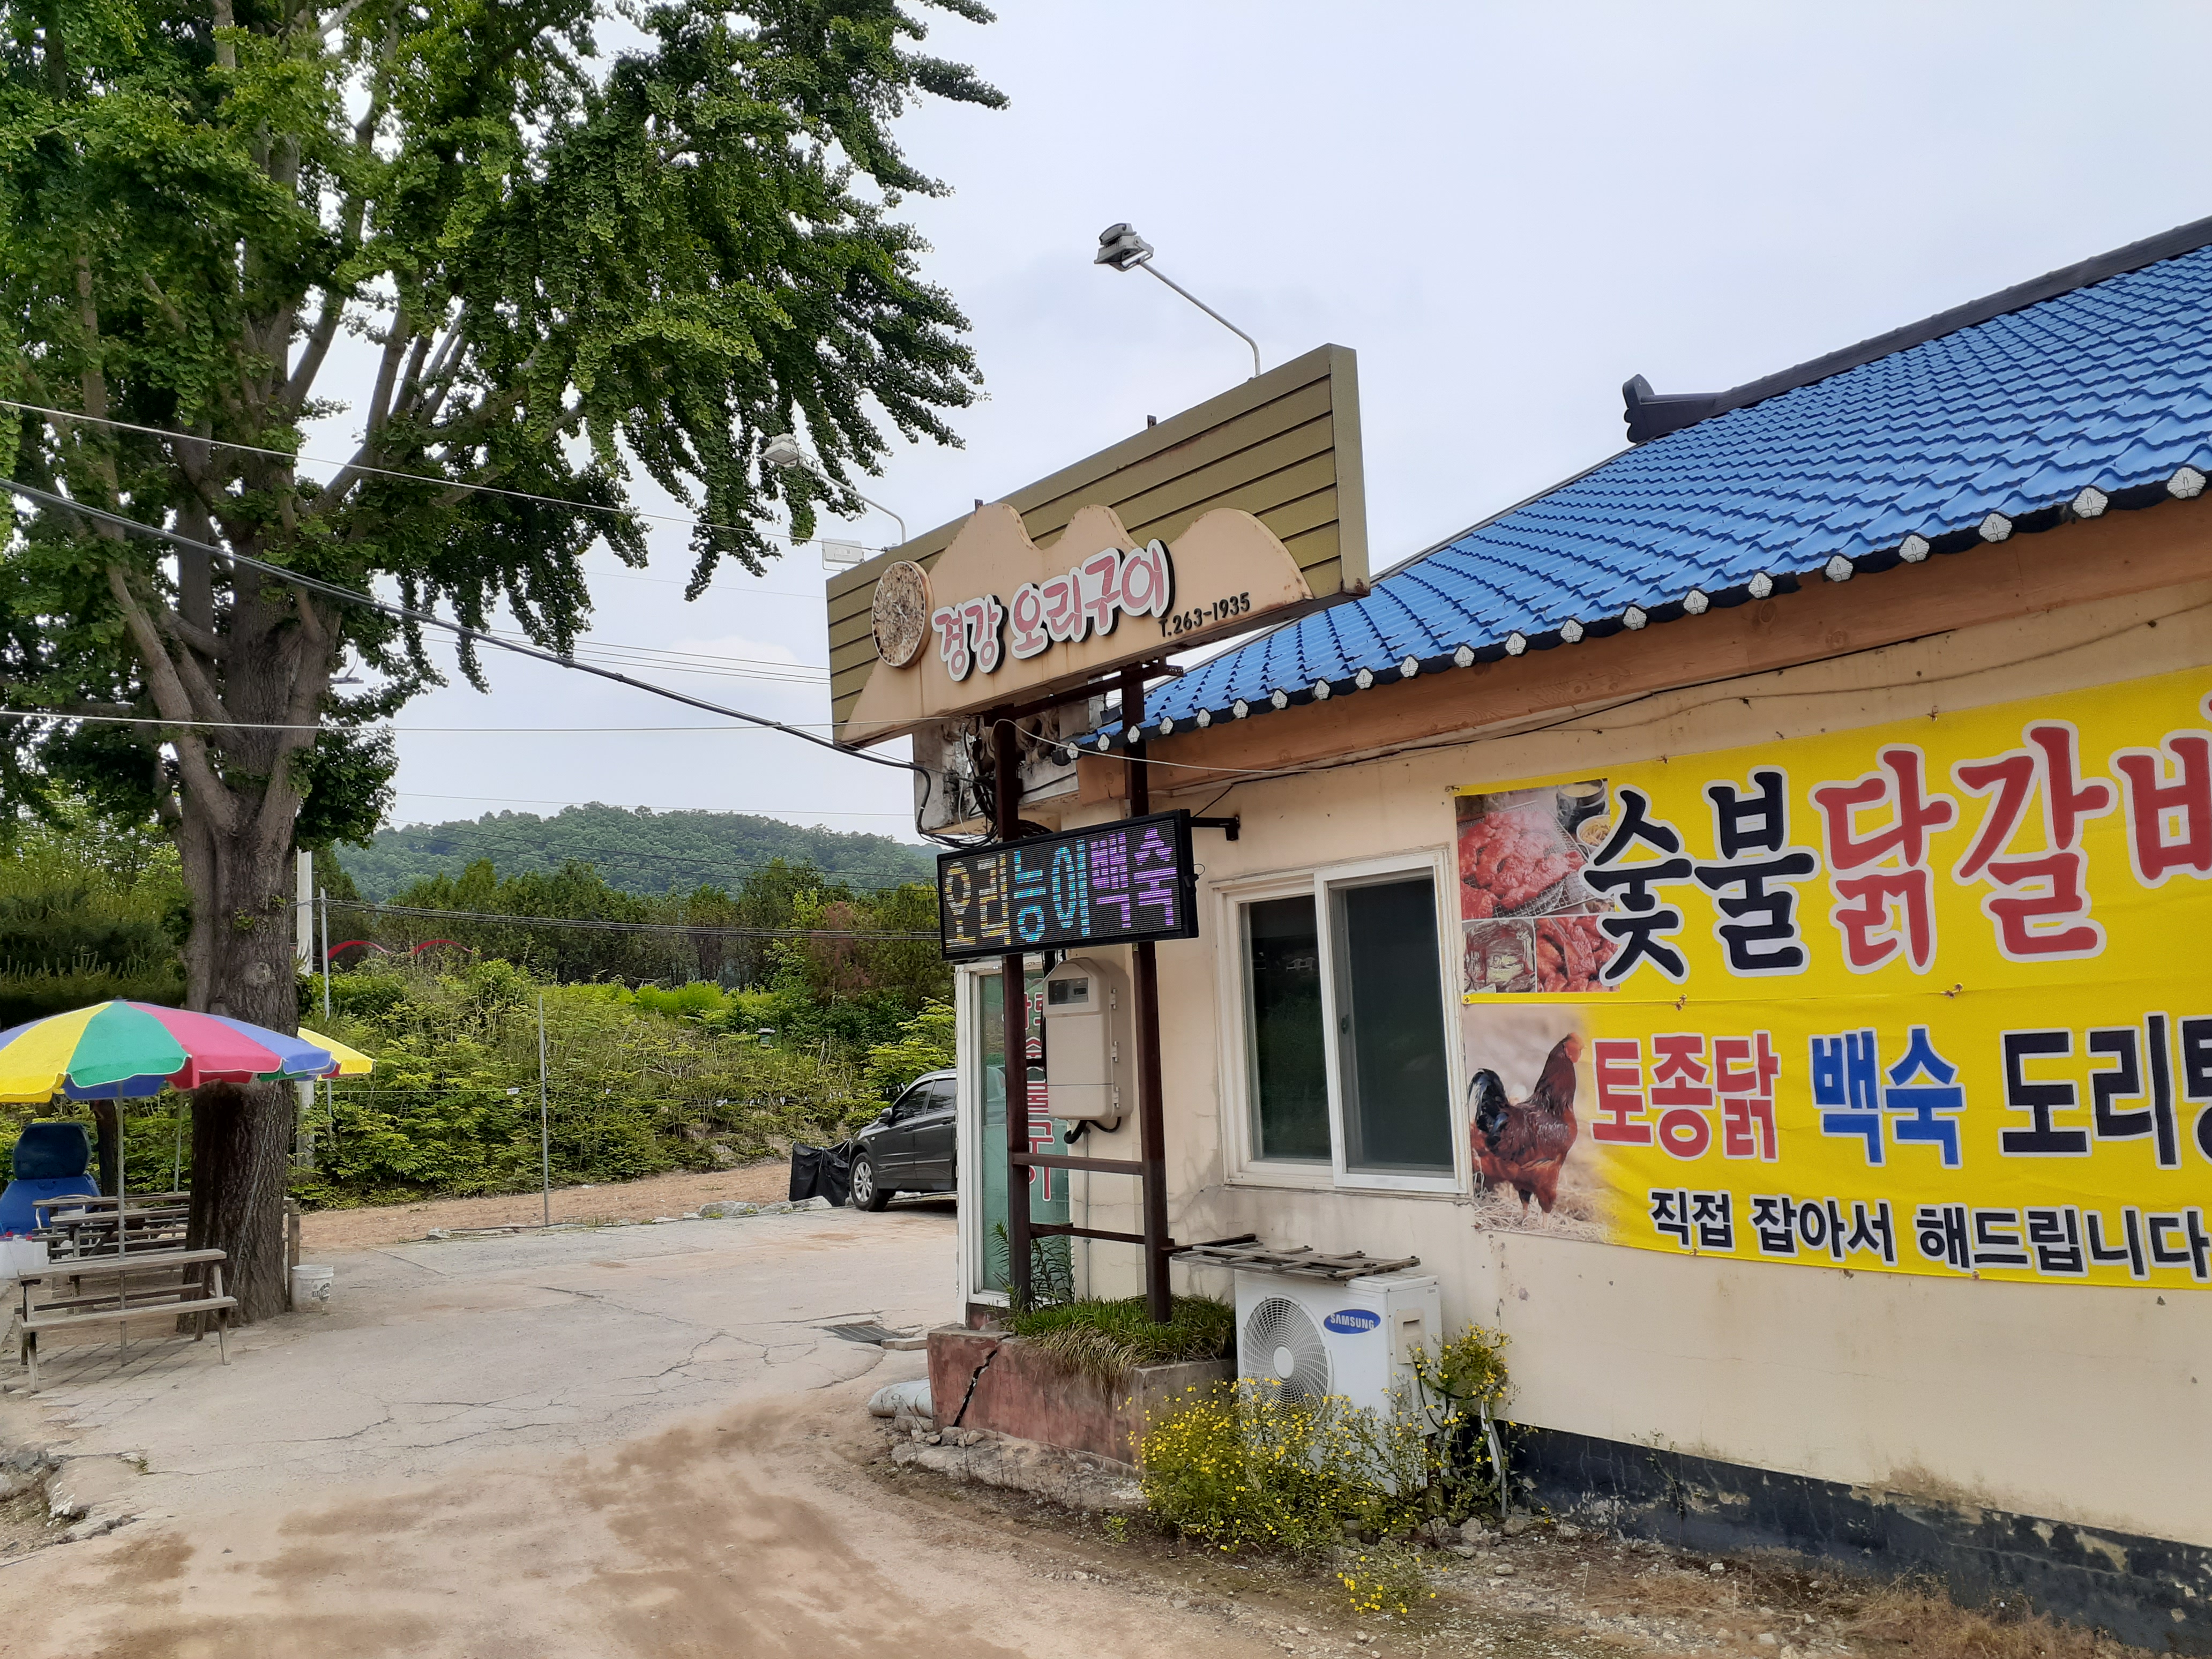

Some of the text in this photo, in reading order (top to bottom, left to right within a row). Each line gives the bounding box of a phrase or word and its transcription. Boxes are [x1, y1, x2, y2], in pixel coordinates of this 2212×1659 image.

[932, 539, 1170, 682] 경강 오리구이
[1158, 592, 1250, 637] T.263-1935
[1592, 1032, 1778, 1160] 토종닭
[1813, 1026, 1964, 1167] 백숙
[1650, 1189, 2211, 1279] 직접 잡아서 해드립니다
[1330, 1313, 1374, 1329] SAMSUNG
